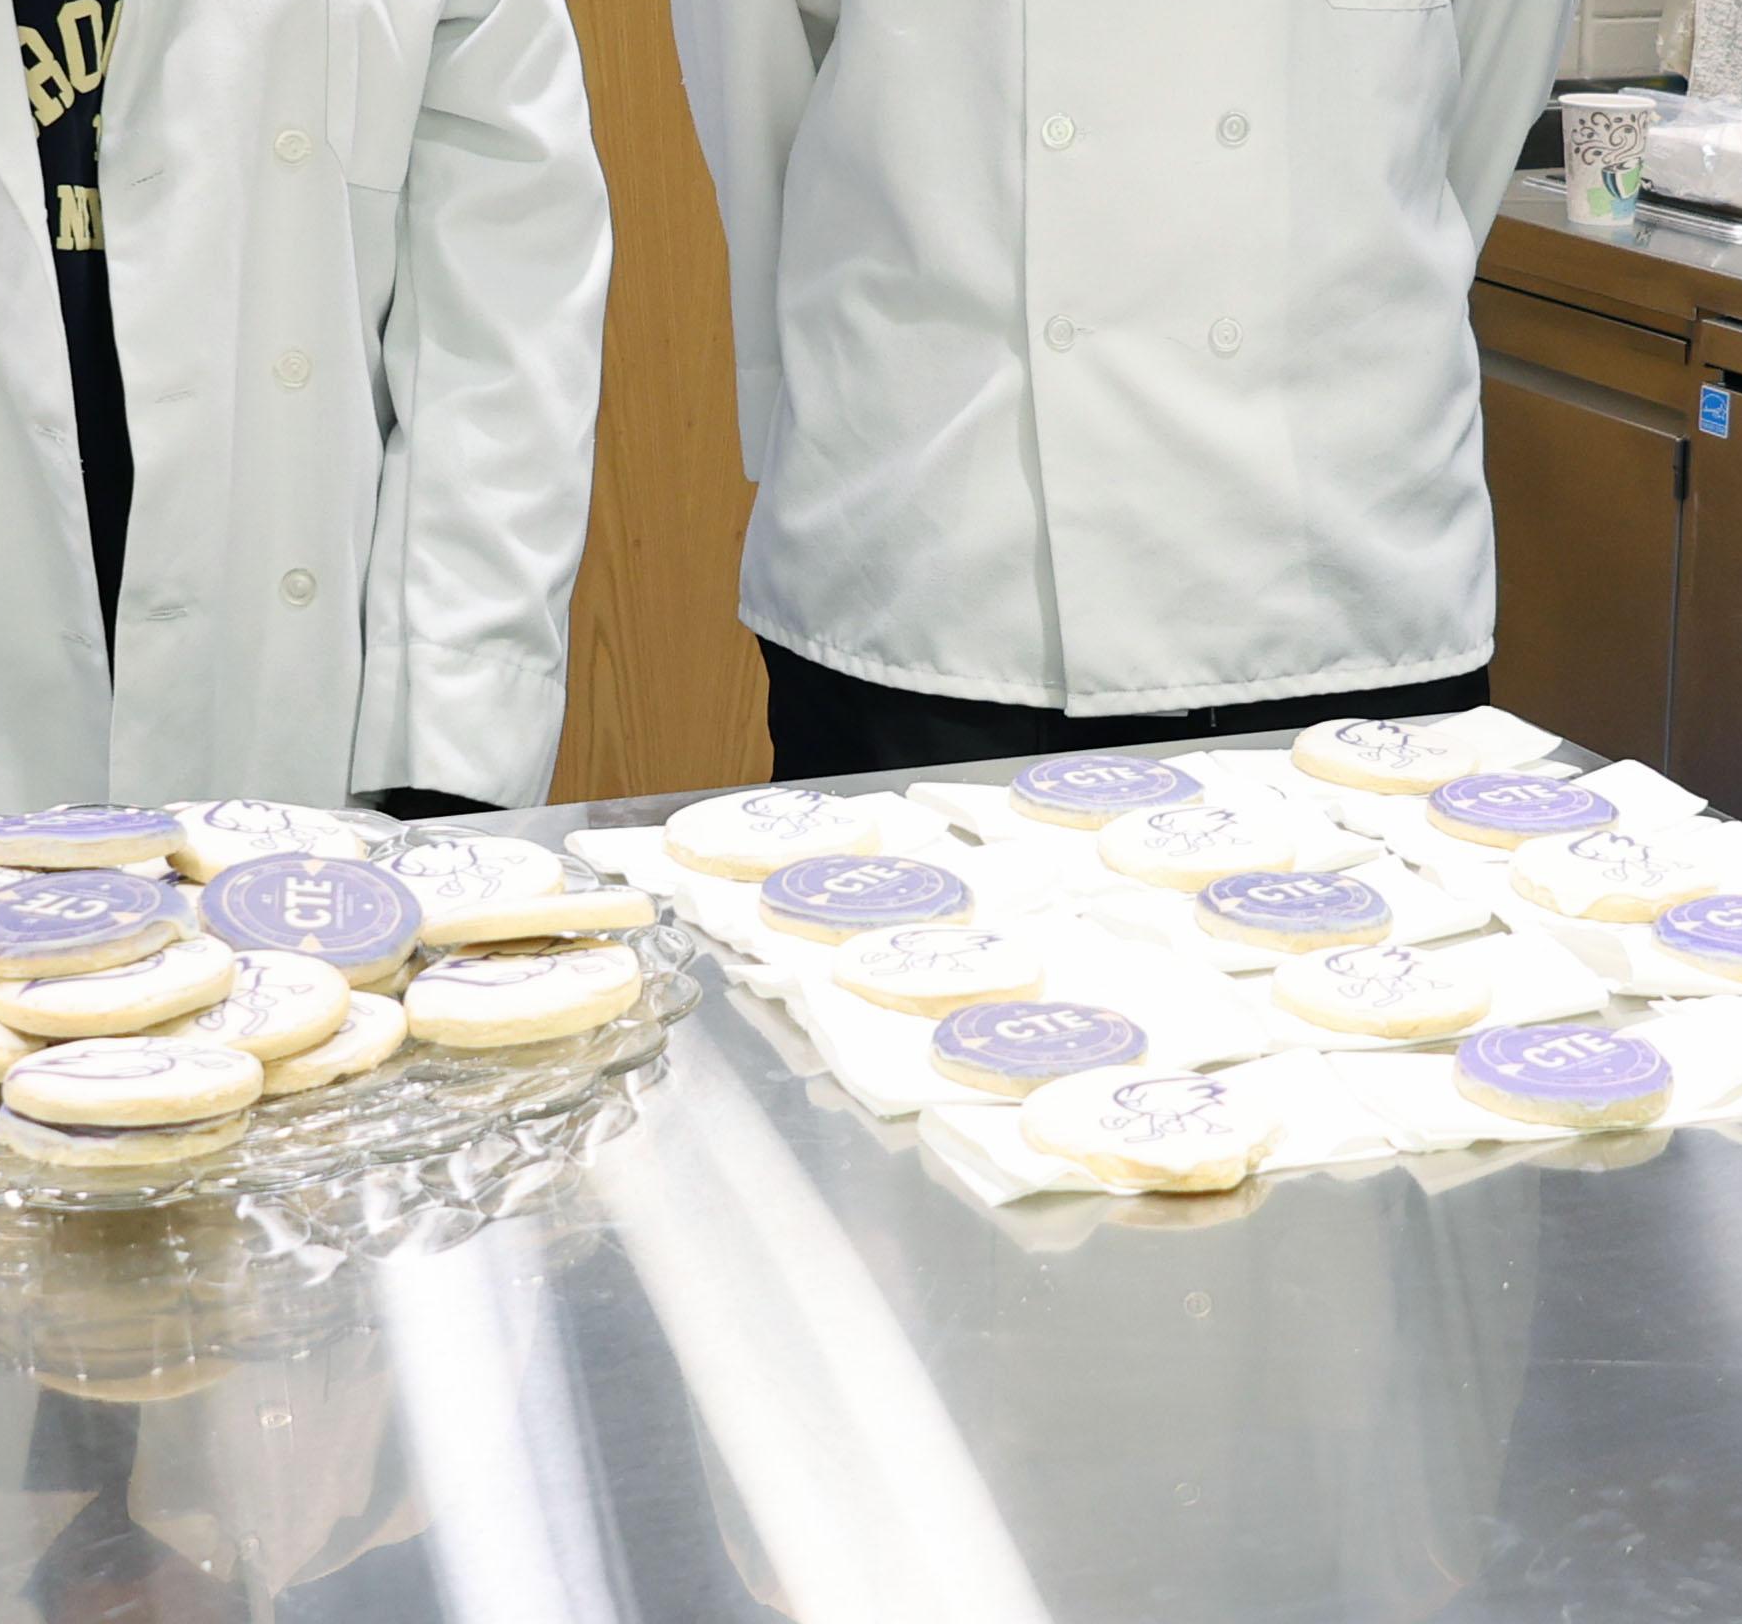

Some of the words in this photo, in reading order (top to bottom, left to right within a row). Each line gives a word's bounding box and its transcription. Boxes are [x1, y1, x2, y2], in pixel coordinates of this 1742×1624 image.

[1061, 761, 1146, 788] CTE
[1480, 780, 1556, 808] CTE
[822, 863, 905, 897] CTE
[1247, 876, 1335, 906] CTE
[10, 891, 109, 921] CTE
[283, 875, 332, 930] CTE
[994, 1008, 1095, 1045] CTE
[1522, 1031, 1617, 1068] CTE
